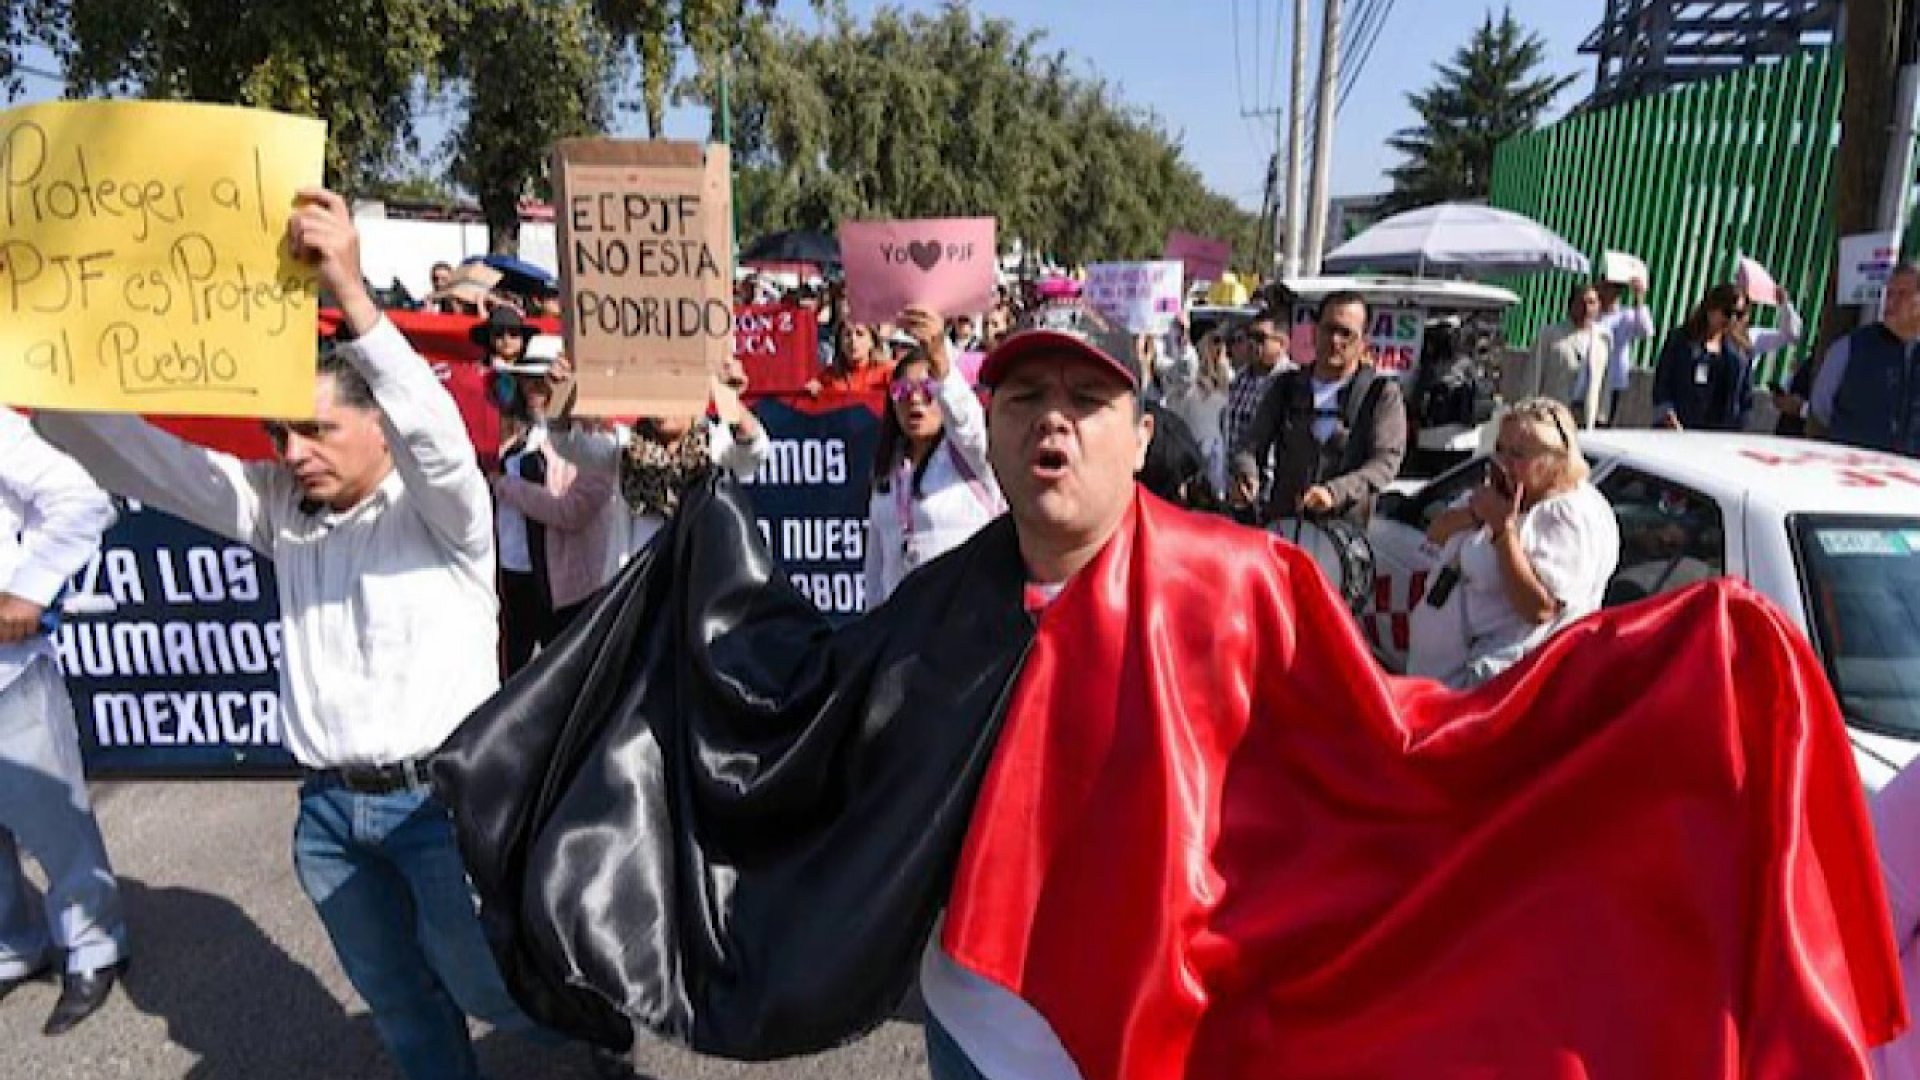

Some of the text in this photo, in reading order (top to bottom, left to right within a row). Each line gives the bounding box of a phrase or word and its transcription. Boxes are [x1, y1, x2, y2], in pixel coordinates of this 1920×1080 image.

[5, 119, 268, 243] Proteger al
[622, 194, 701, 236] PJF
[0, 239, 114, 314] PJF
[575, 239, 720, 280] NO ESTA
[879, 243, 975, 265] Yo PJF
[576, 290, 731, 341] PODRIDO
[24, 321, 240, 389] al Pueblo
[782, 518, 869, 561] NUES
[155, 546, 261, 602] LOS
[92, 690, 280, 746] MEXICA
